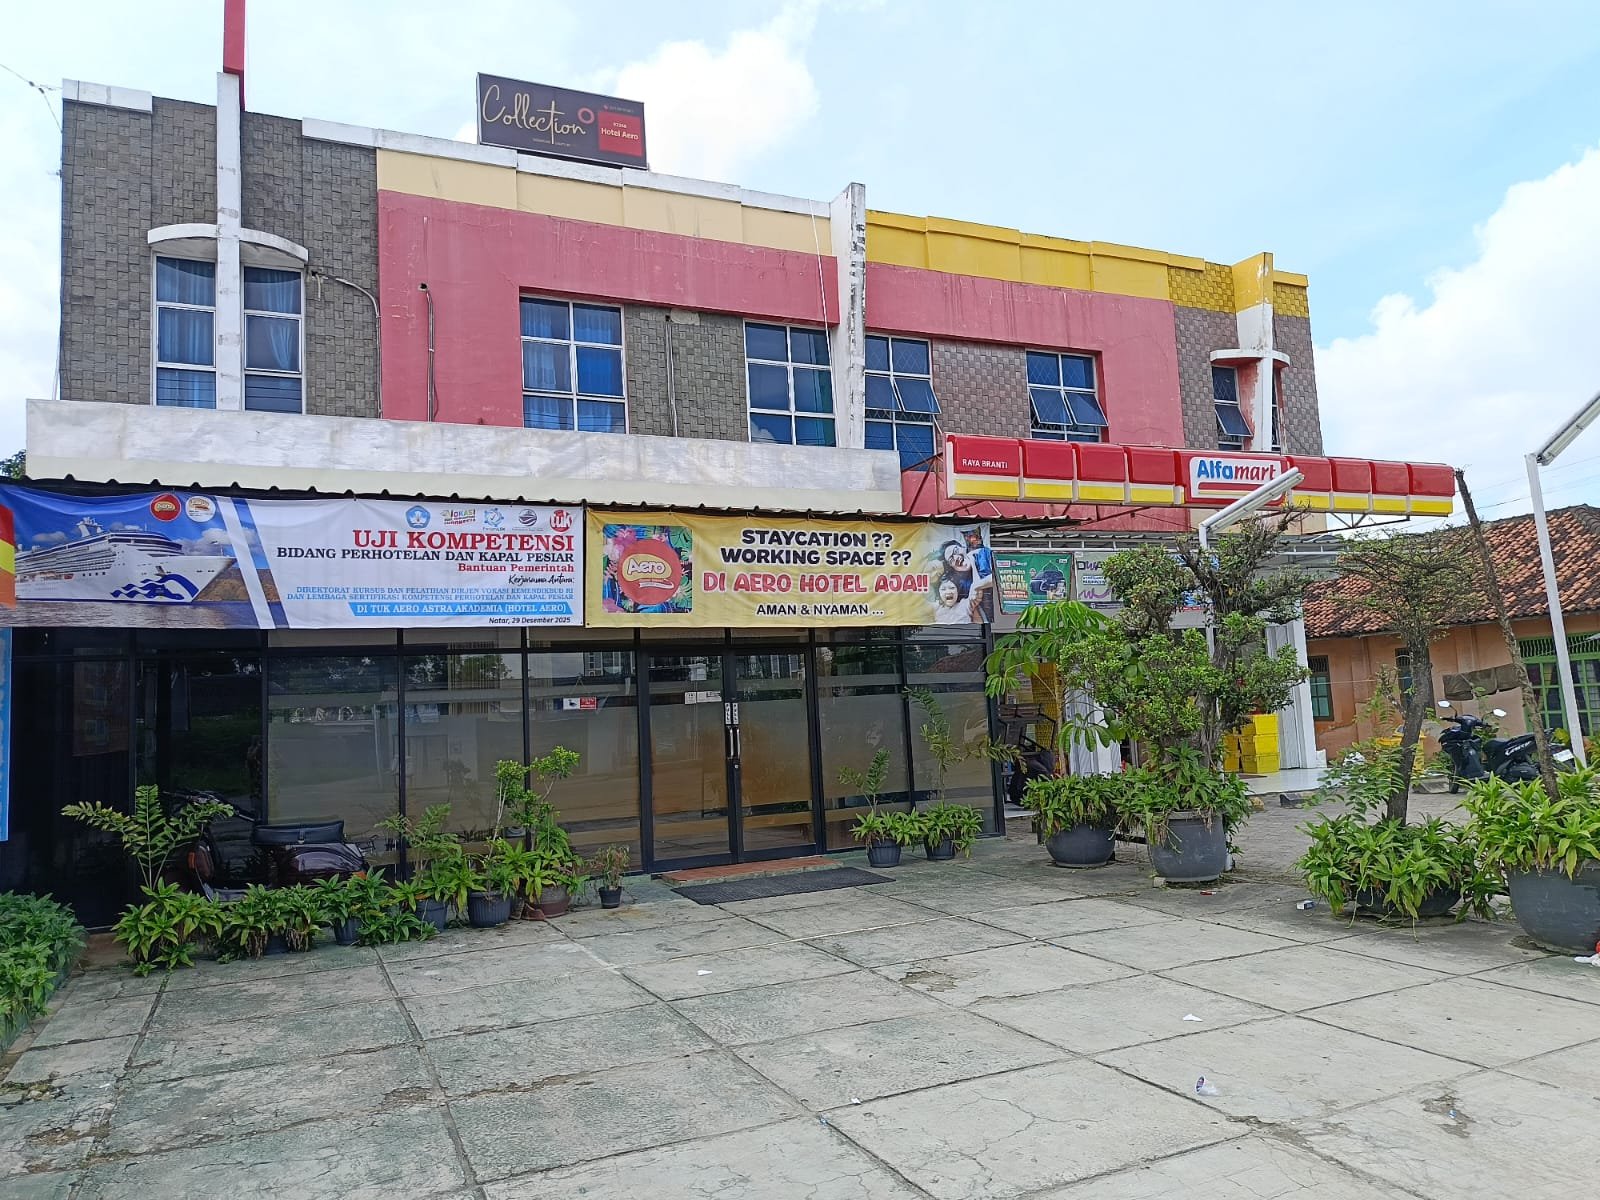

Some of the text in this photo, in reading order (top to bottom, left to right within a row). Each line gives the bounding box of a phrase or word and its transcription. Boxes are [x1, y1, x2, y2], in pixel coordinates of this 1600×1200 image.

[482, 84, 586, 145] Collection
[601, 127, 639, 140] Hotel Aero
[962, 458, 1008, 469] RAYA BRANTI
[1197, 459, 1277, 480] Alfamart
[353, 530, 574, 551] UJI KOMPETENSI
[742, 530, 893, 547] STAYCATION ??
[277, 547, 575, 563] BIDANG PERHOTELAN DAN KAPAL PESIAR
[720, 548, 912, 566] WORKING SPACE ??
[458, 563, 575, 573] Bantuan Pemerintah
[627, 559, 666, 575] Aero
[296, 586, 350, 594] DIREKTORAT
[704, 572, 928, 592] DI AERO HOTEL AJA!!
[357, 603, 566, 613] DI TUK AERO ASTRA AKADEMIA (HOTEL AERO)
[757, 604, 796, 615] AMAN
[801, 605, 809, 615] &
[814, 605, 868, 615] NYAMAN
[489, 617, 511, 625] Natar,
[522, 616, 554, 624] Desember
